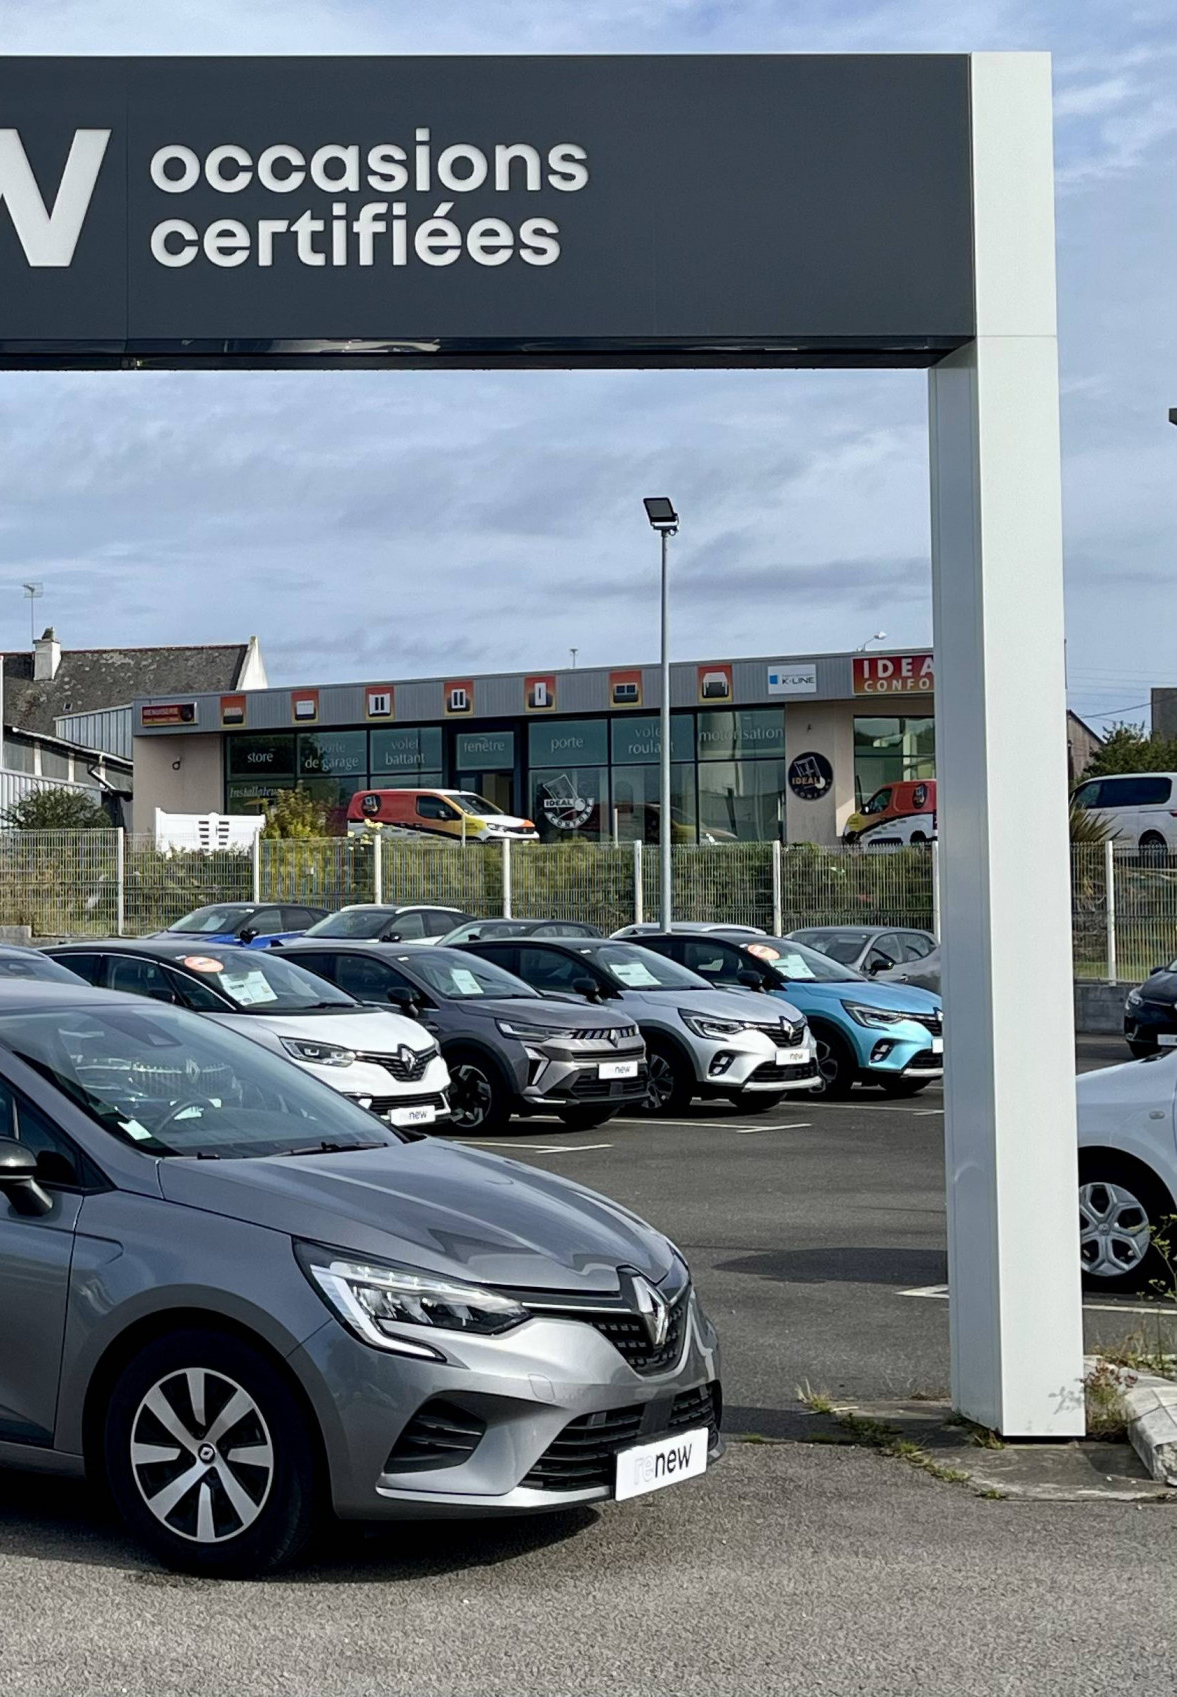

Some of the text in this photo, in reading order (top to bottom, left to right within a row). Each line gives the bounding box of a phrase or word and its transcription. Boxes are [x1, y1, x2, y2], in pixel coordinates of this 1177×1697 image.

[150, 127, 590, 194] occasions
[150, 201, 562, 268] certifiées
[864, 657, 934, 679] IDEA
[864, 678, 930, 692] CONFO
[635, 723, 661, 738] vole
[391, 738, 419, 750] volet
[464, 737, 505, 752] fenêtre
[551, 735, 584, 751] porte
[628, 739, 675, 754] roulat
[247, 752, 274, 763] store
[305, 756, 359, 771] de garage
[385, 752, 426, 765] battant
[792, 776, 819, 785] IDEAL
